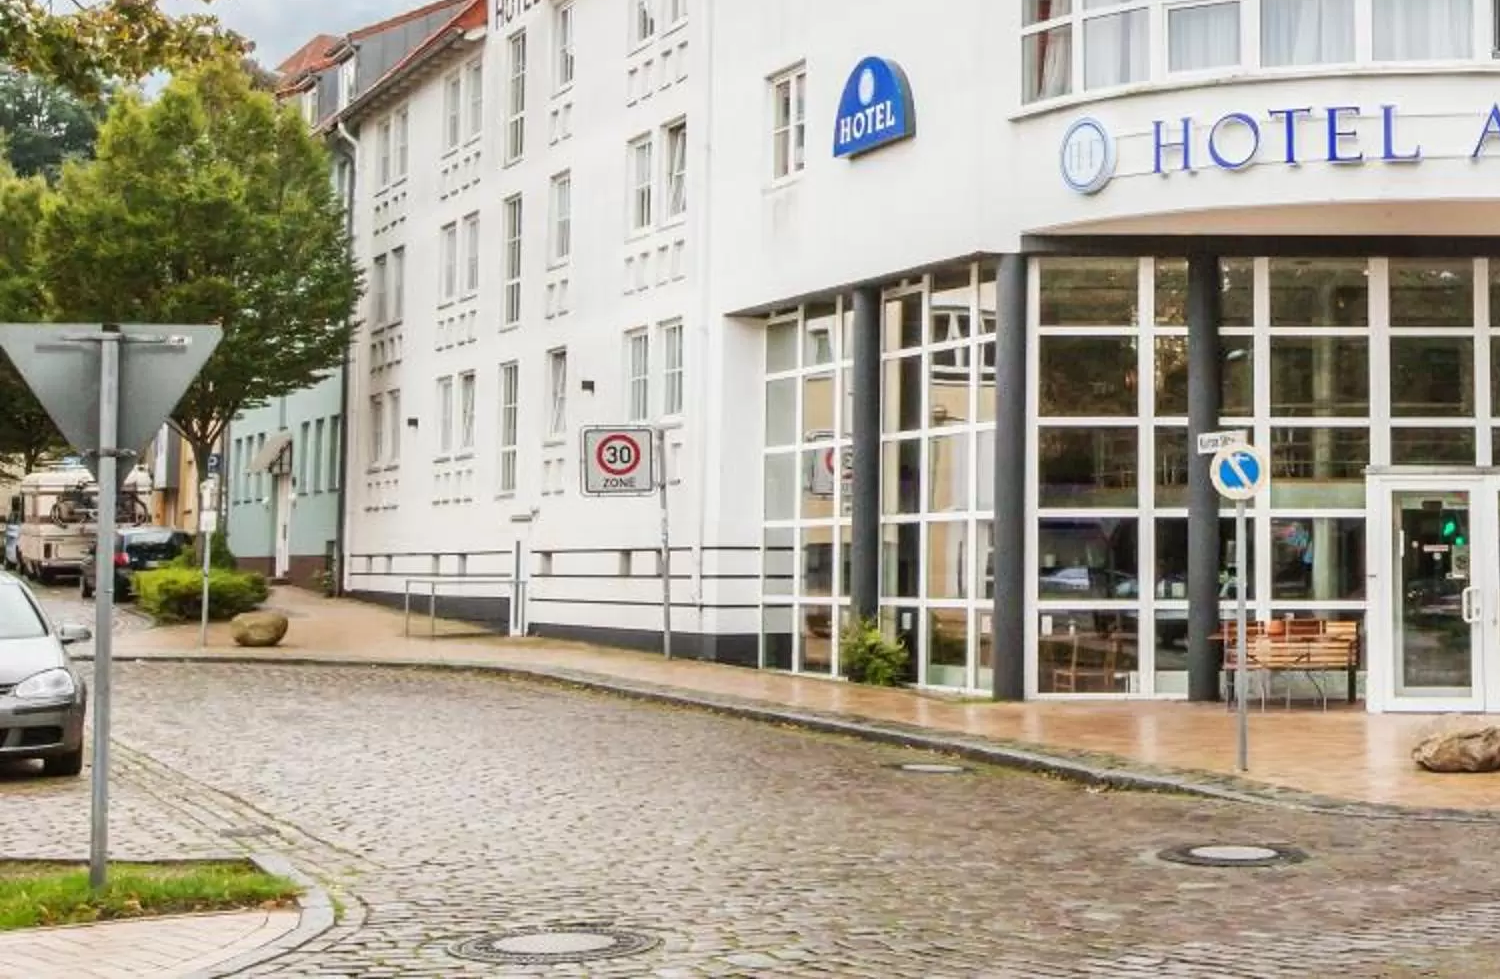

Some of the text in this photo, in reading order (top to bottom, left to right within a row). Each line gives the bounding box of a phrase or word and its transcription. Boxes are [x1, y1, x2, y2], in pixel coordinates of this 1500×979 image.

[840, 100, 896, 145] HOTEL
[1152, 104, 1421, 175] HOTEL
[606, 445, 632, 465] 30
[603, 478, 636, 488] ZONE
